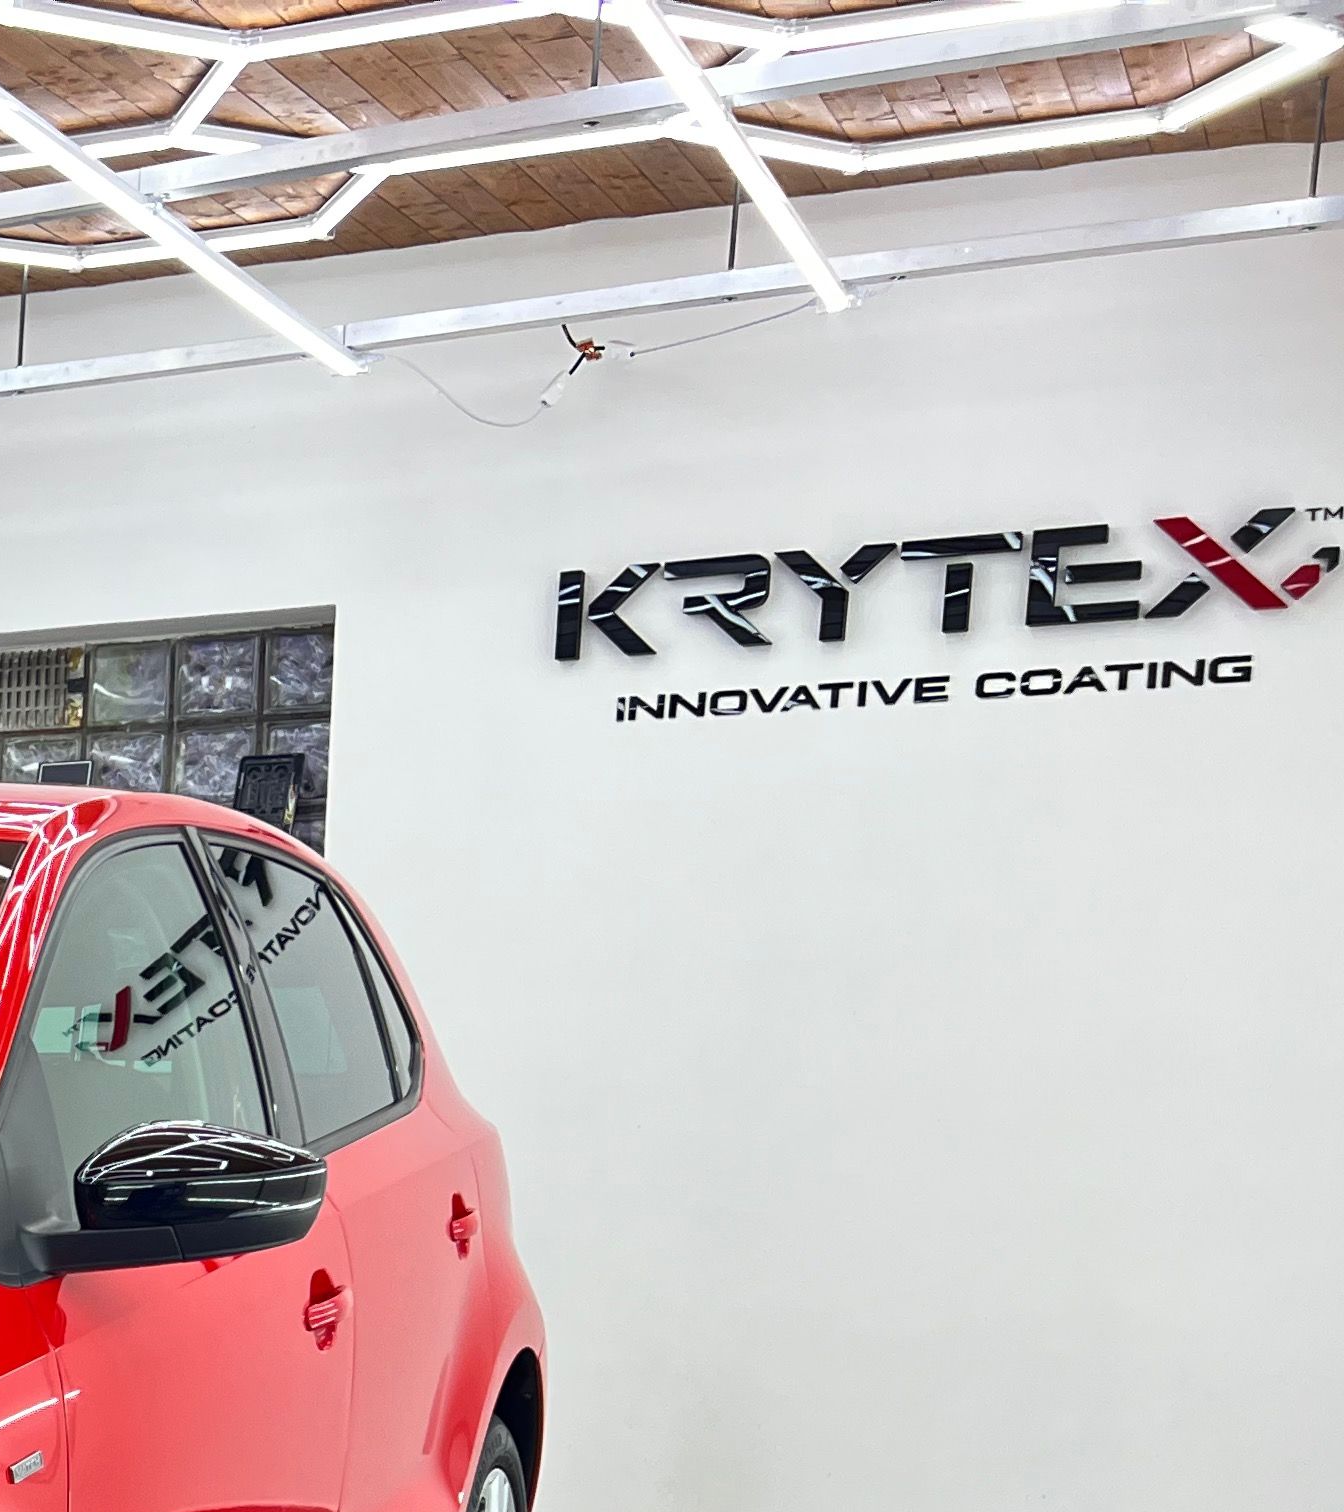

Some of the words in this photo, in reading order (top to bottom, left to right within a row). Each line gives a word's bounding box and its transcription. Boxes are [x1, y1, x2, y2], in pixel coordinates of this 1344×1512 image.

[555, 507, 1297, 661] KRYTEX
[616, 676, 951, 722] INNOVATIVE
[976, 655, 1254, 700] COATING
